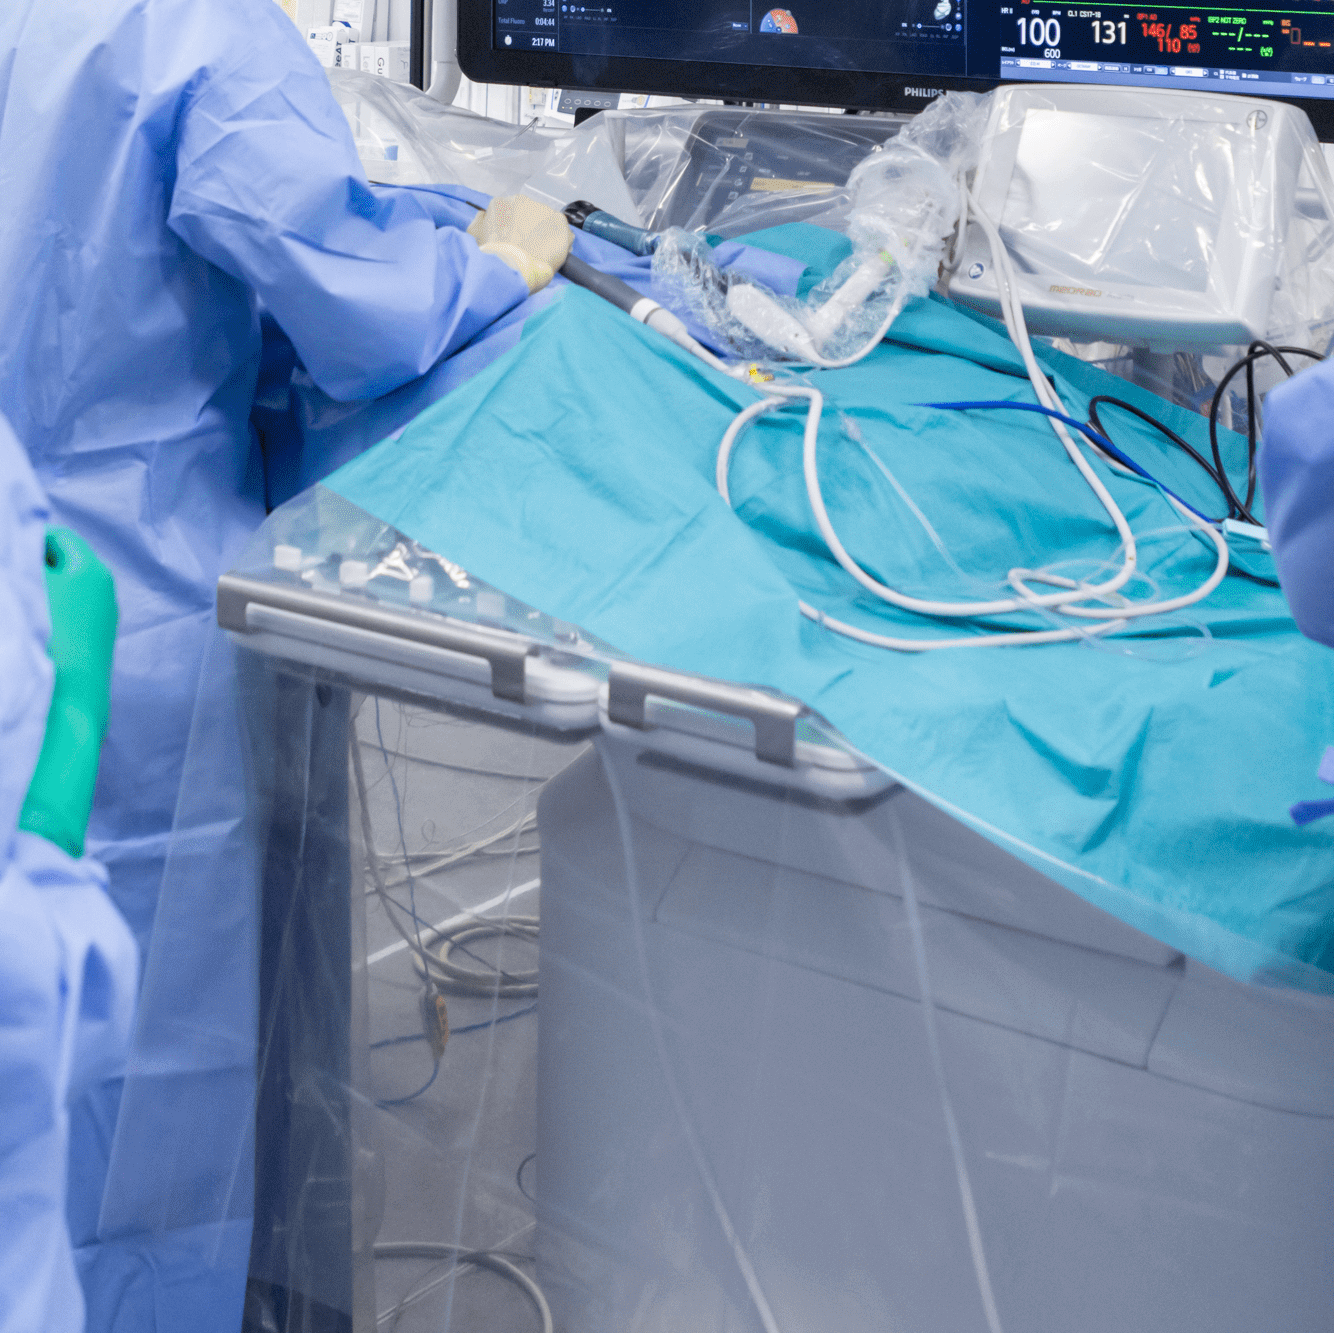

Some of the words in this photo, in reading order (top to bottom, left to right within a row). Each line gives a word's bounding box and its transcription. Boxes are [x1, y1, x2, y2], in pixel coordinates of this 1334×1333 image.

[543, 0, 555, 7] 3.34
[535, 18, 555, 26] 0:04:44
[1232, 17, 1247, 25] ZERO
[1017, 17, 1061, 46] 100
[1091, 20, 1126, 45] 131
[1179, 24, 1198, 39] 85
[532, 38, 544, 46] 2:17
[545, 39, 555, 47] PM
[1157, 38, 1181, 53] 110
[1044, 49, 1061, 58] 600
[904, 86, 944, 98] PHILIPS
